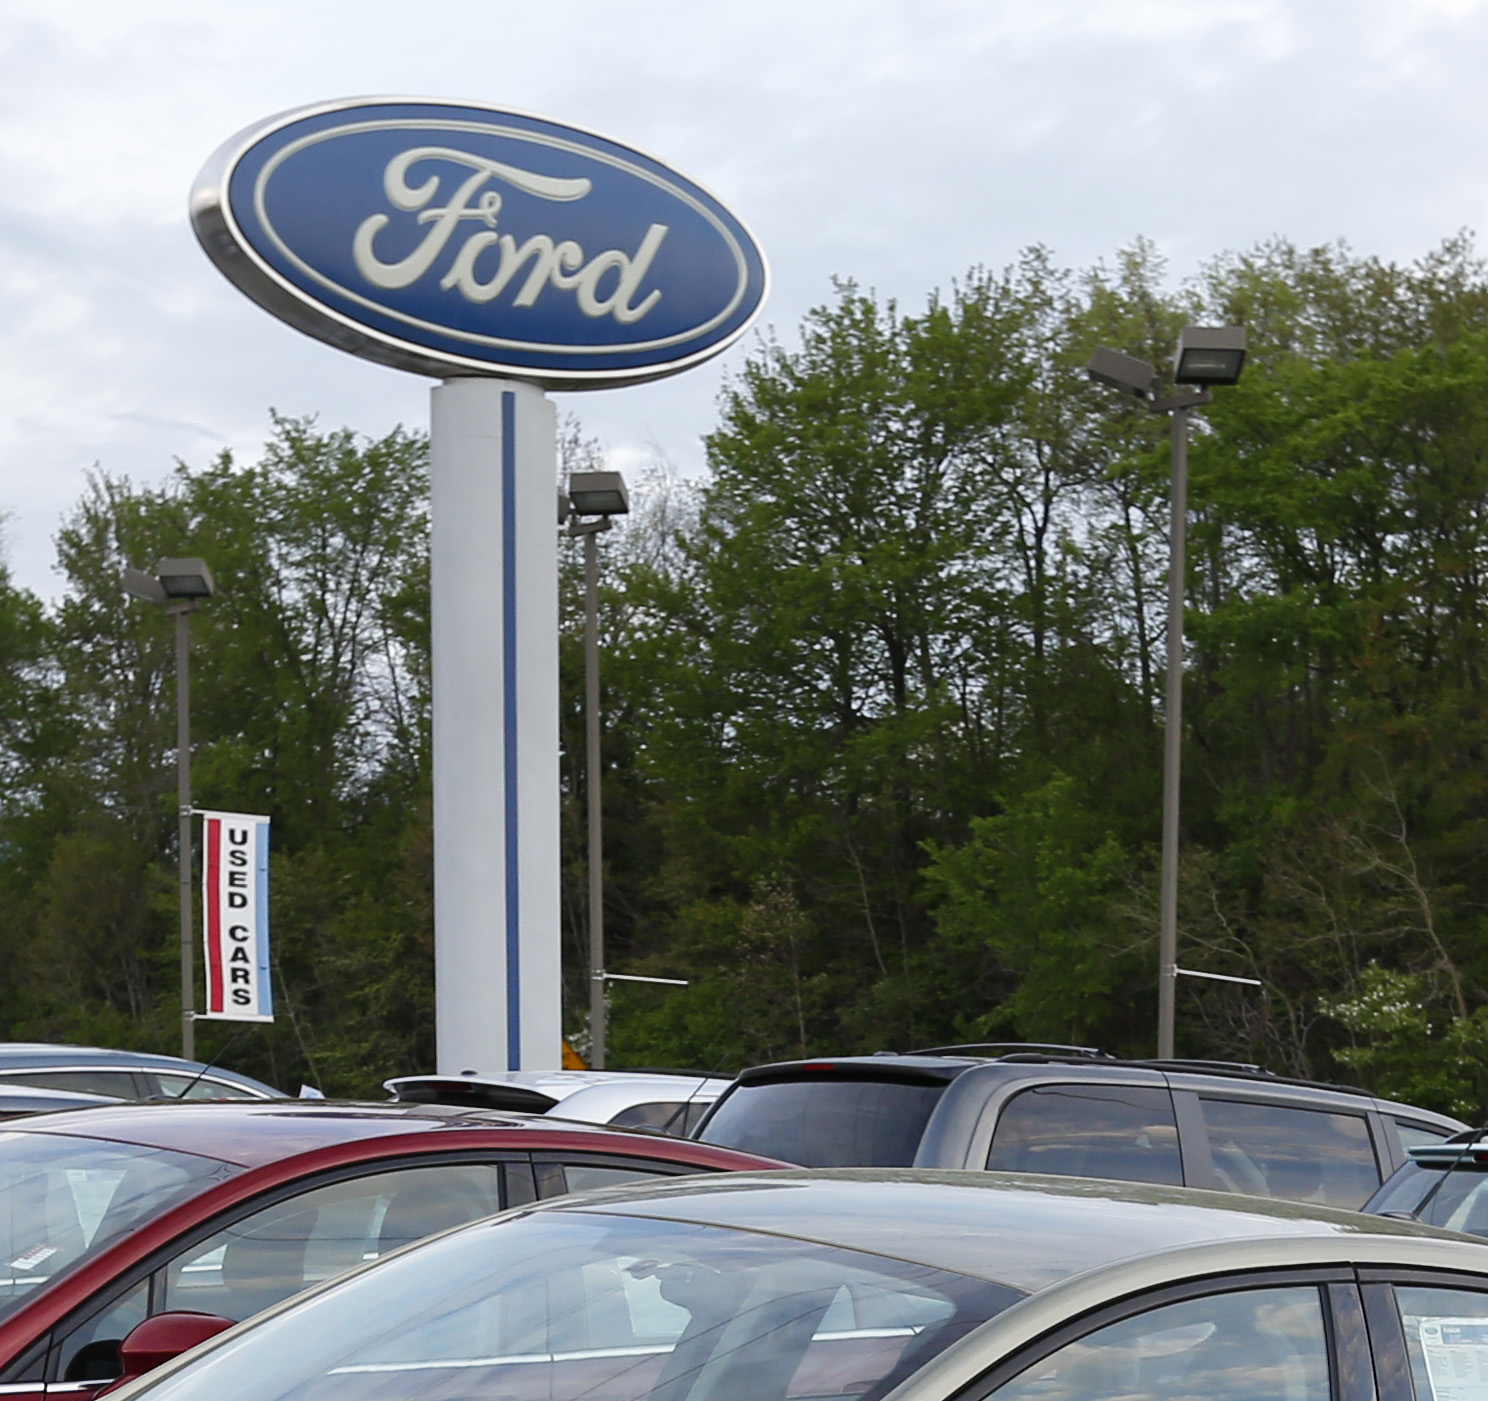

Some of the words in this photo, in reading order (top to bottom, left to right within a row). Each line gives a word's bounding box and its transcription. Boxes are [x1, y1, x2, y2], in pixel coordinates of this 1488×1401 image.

[353, 145, 670, 325] Ford
[228, 828, 248, 909] USED
[229, 925, 251, 1006] CARS
